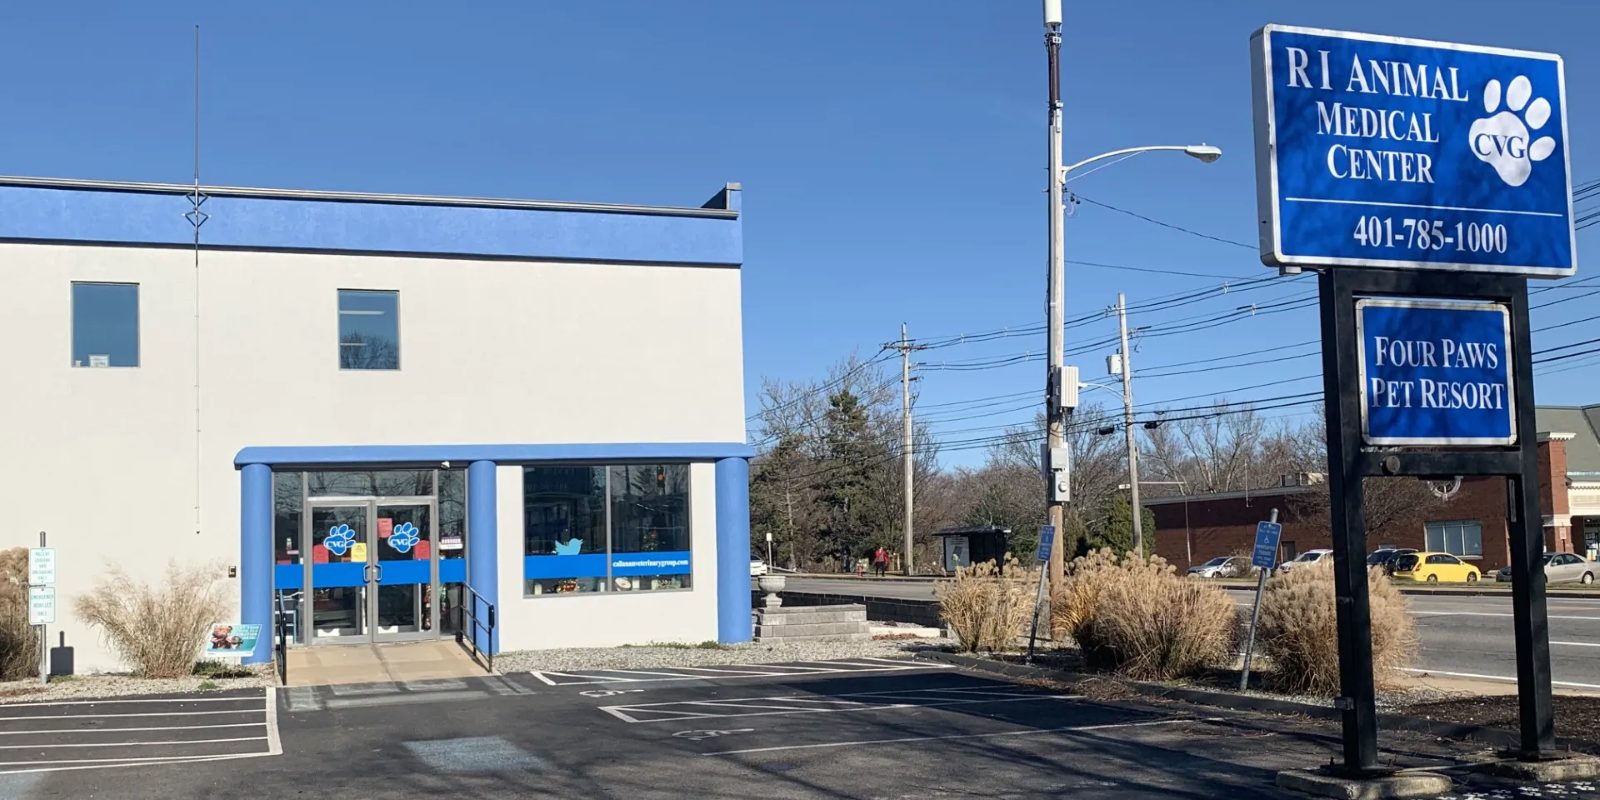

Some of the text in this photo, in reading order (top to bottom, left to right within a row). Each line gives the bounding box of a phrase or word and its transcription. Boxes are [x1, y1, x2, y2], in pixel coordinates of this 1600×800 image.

[1286, 46, 1470, 103] R I ANIMAL
[1315, 101, 1440, 144] MEDICAL
[1473, 132, 1527, 160] CVG
[1327, 144, 1436, 184] CENTER
[1353, 215, 1508, 255] 401-785-1000
[1373, 336, 1499, 370] FOUR PAWS
[1371, 377, 1505, 410] PET RESORT
[325, 540, 344, 548] CVG
[390, 538, 409, 546] CVG
